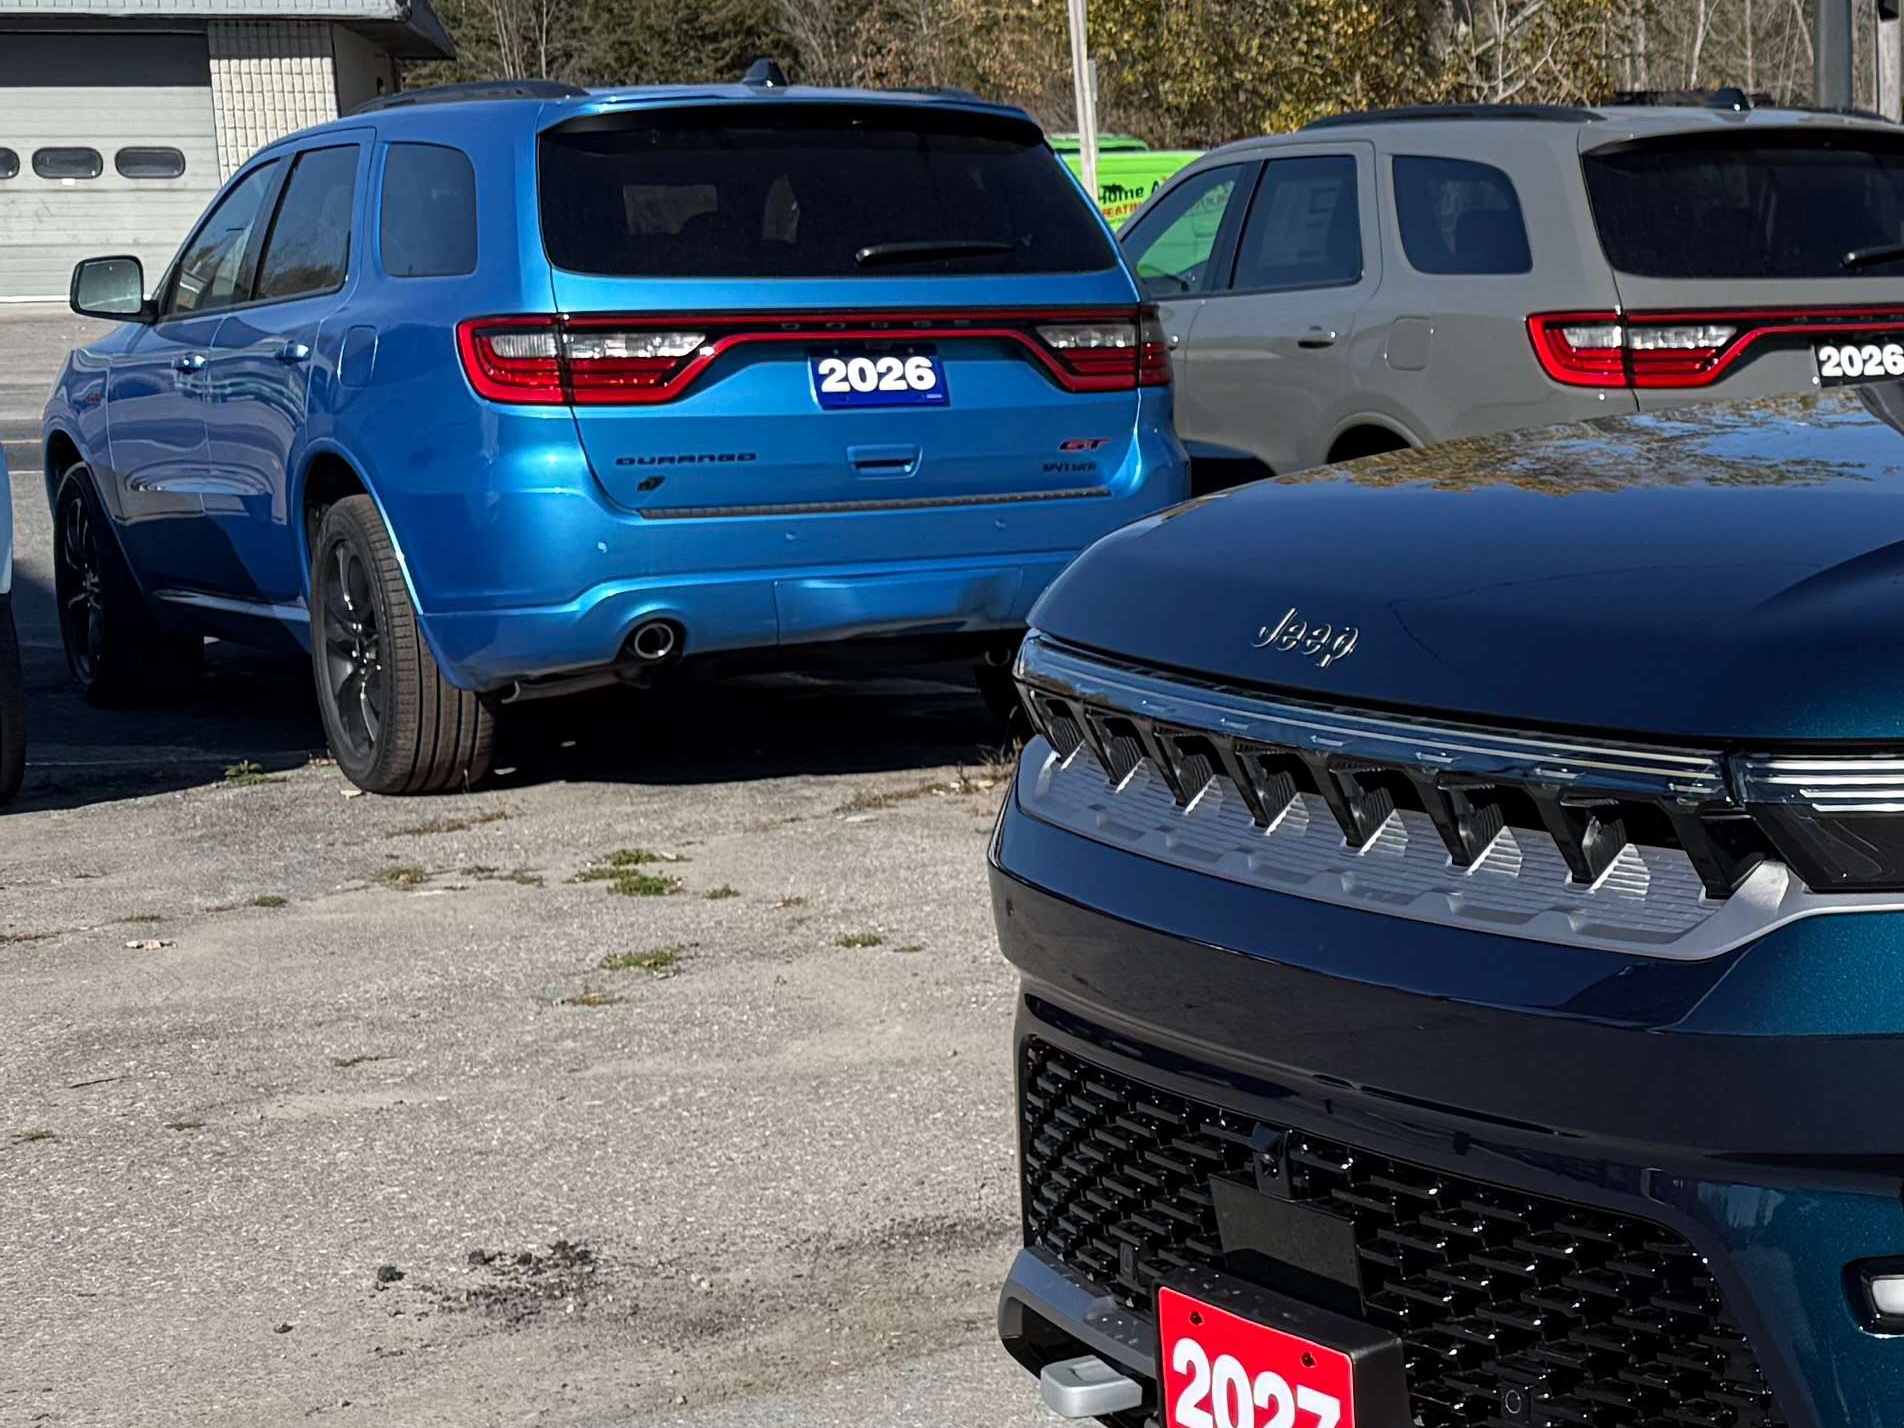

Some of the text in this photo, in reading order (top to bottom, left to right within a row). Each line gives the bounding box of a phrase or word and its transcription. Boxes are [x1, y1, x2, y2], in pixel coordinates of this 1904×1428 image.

[818, 356, 937, 393] 2026
[615, 452, 757, 466] DURANGO
[1250, 607, 1359, 668] Jeep
